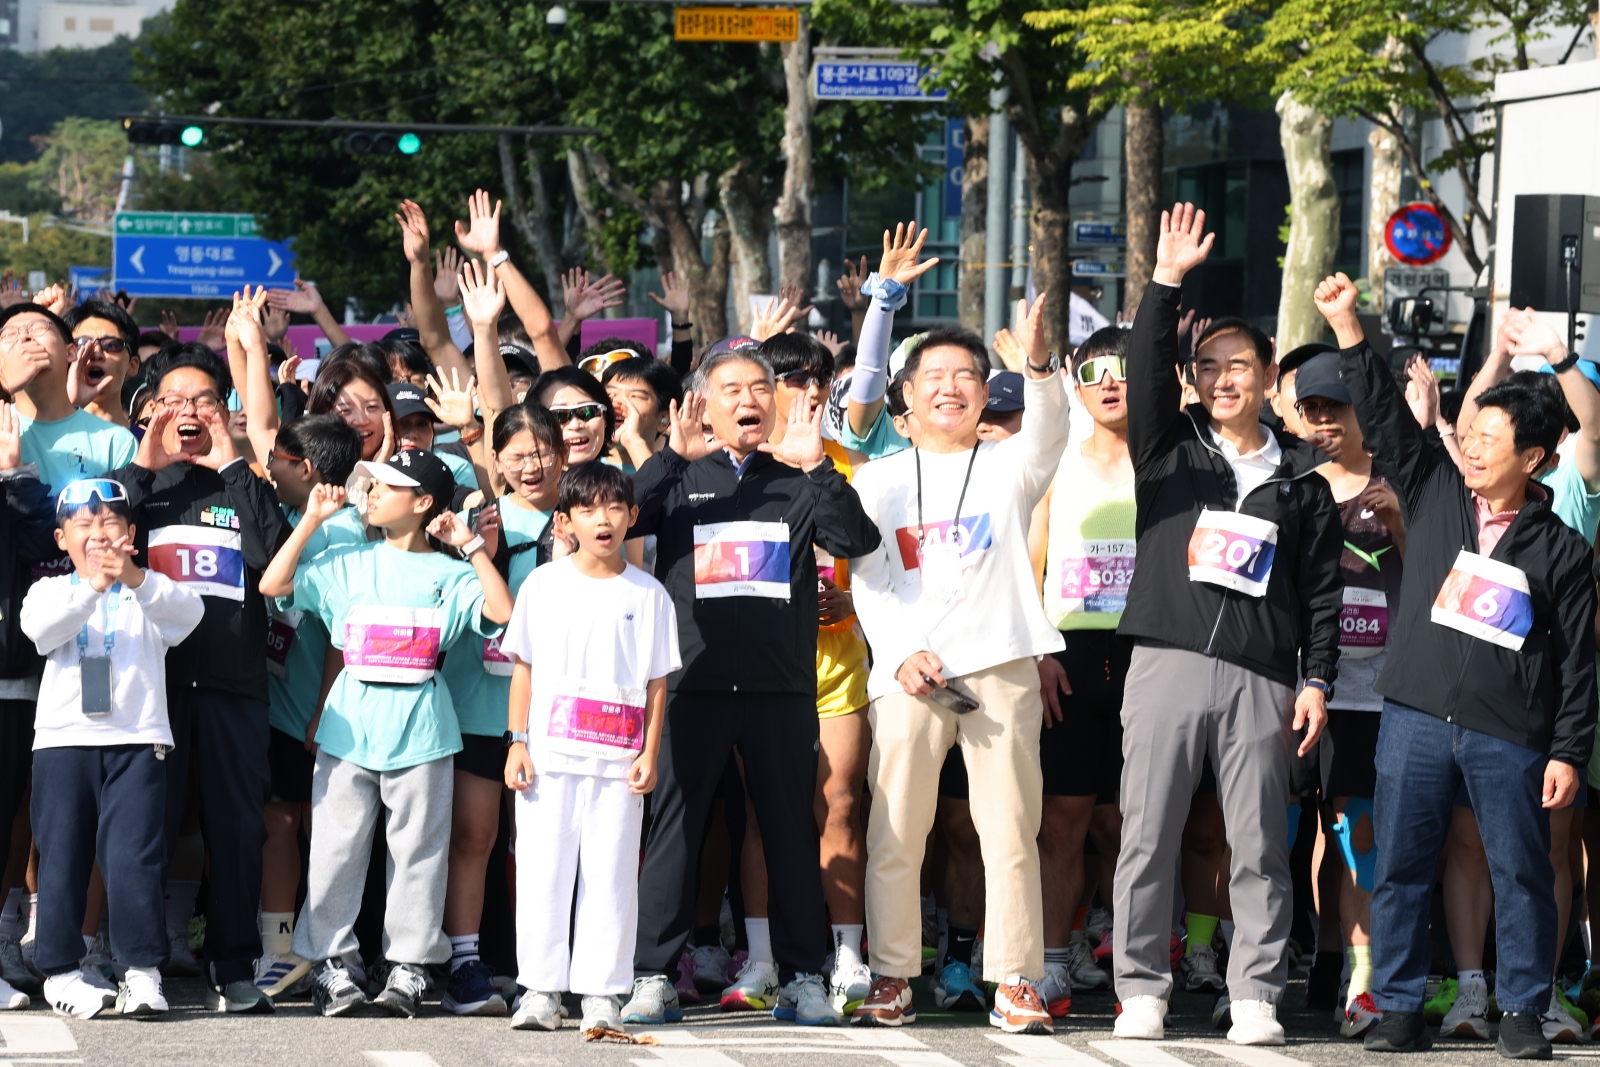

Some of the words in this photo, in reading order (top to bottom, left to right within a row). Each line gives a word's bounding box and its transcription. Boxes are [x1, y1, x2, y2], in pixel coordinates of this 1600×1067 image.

[174, 245, 236, 263] 영동대로
[1389, 273, 1445, 287] 견인지역
[1090, 544, 1125, 555] 가-157
[176, 548, 218, 577] 18
[735, 546, 750, 576] 1
[1063, 569, 1080, 586] A
[1473, 587, 1500, 618] 6
[1339, 616, 1380, 634] 084
